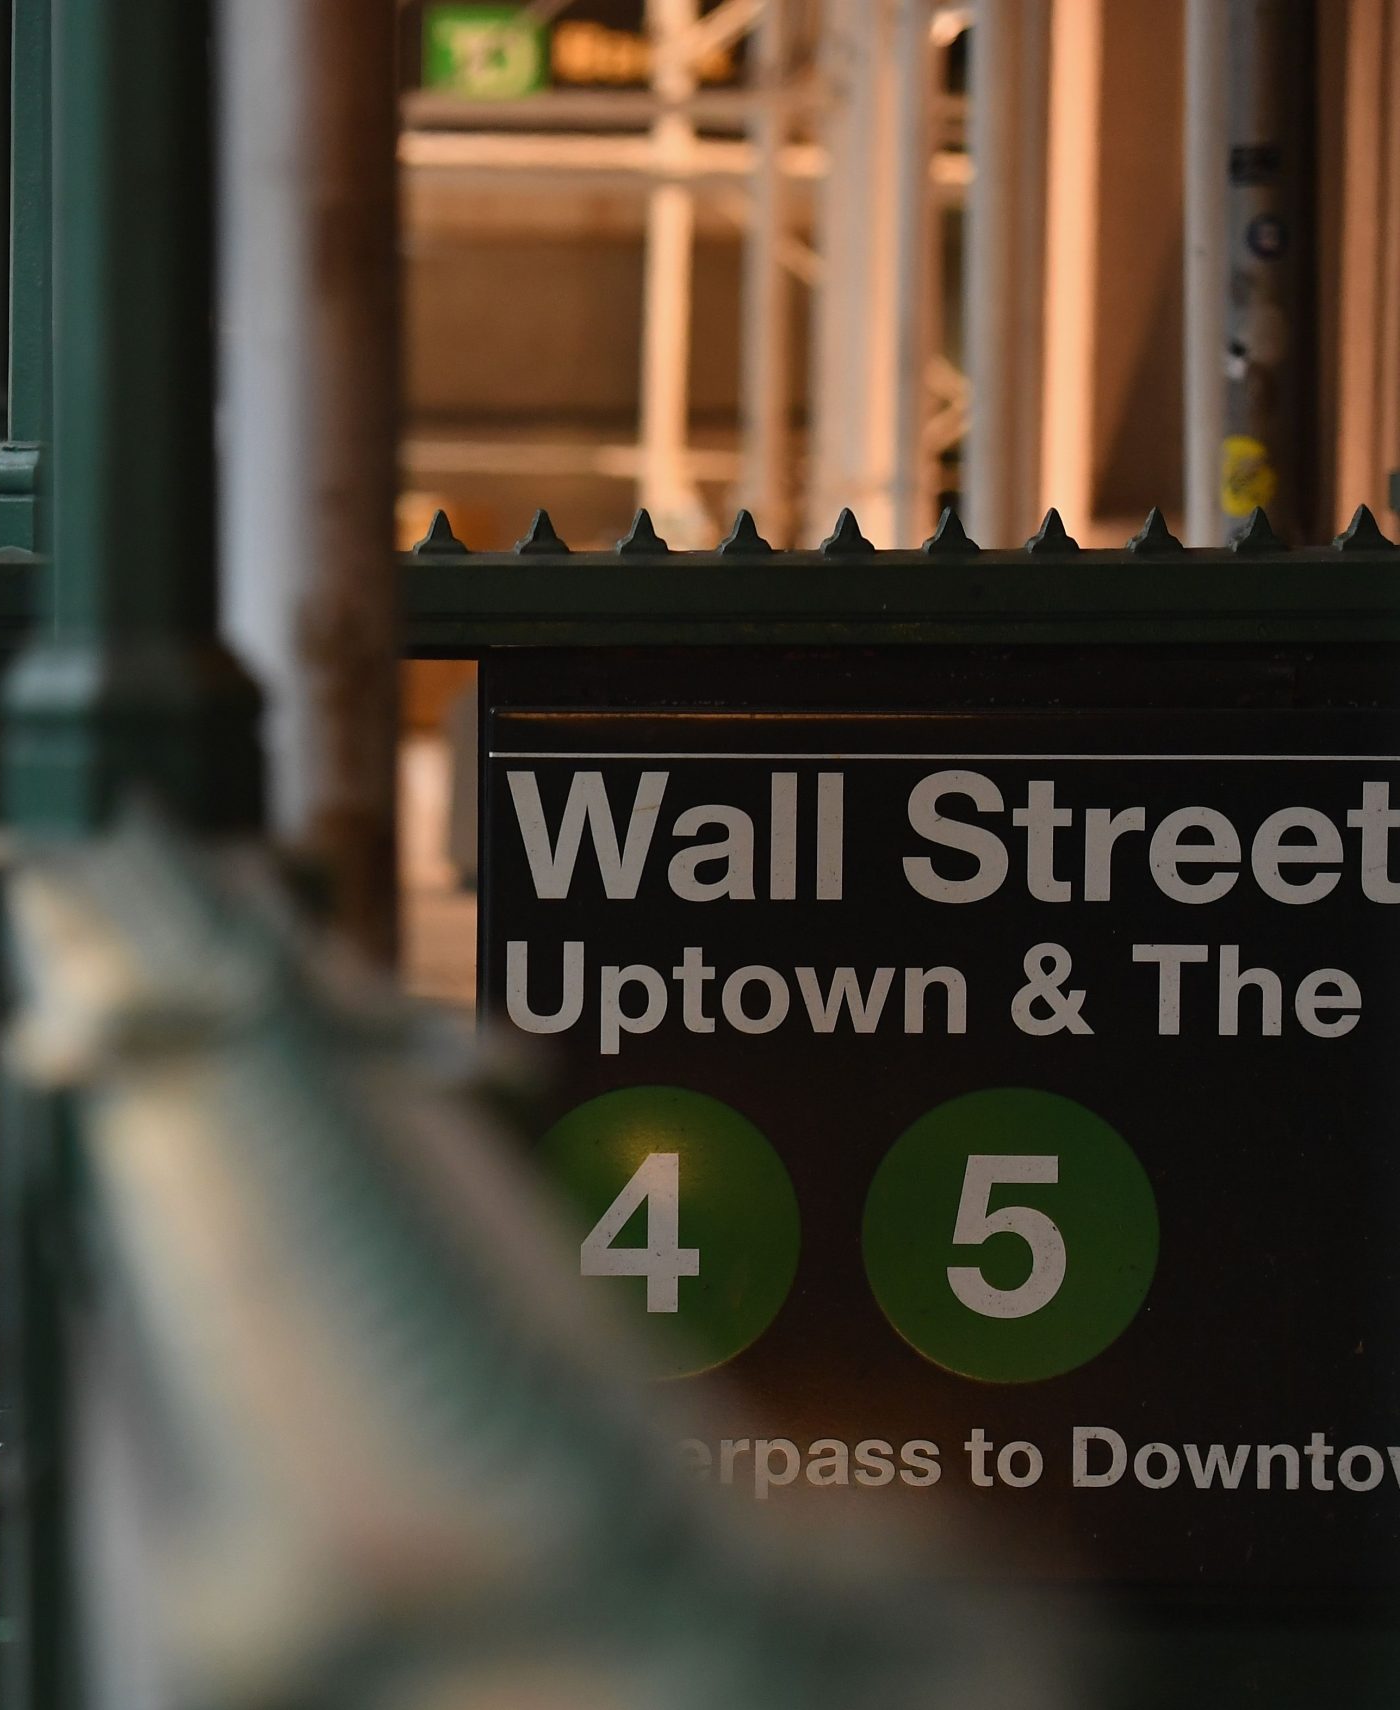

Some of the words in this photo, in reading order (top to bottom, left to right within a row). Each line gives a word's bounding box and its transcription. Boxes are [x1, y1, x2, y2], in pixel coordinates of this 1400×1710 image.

[506, 770, 844, 902] Wall
[902, 769, 1400, 905] Street
[506, 940, 967, 1055] Uptown
[1010, 942, 1095, 1036] &
[1132, 943, 1362, 1038] The
[580, 1152, 700, 1313] 4
[946, 1154, 1067, 1319] 5
[668, 1437, 942, 1500] erpass
[964, 1428, 1044, 1490] to
[1071, 1426, 1400, 1493] Downto
